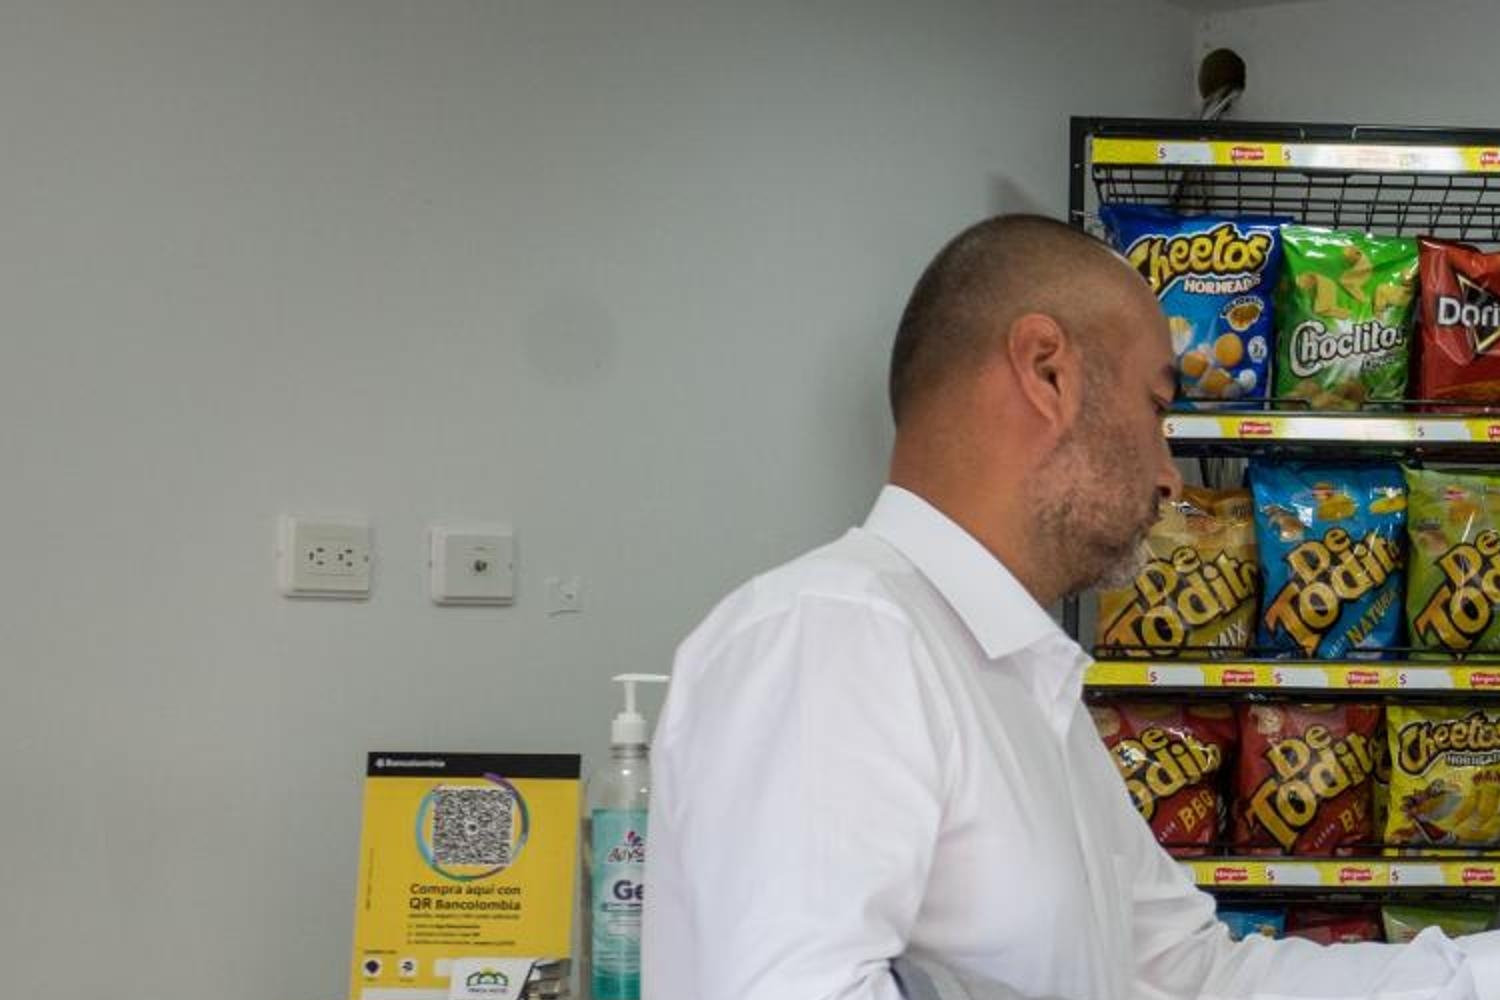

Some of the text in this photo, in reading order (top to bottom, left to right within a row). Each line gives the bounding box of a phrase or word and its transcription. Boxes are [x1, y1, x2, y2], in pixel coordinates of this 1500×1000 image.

[1288, 527, 1351, 585] De
[1246, 724, 1374, 850] De Todit
[409, 883, 463, 896] Compra
[409, 896, 522, 911] QR Bancolombia
